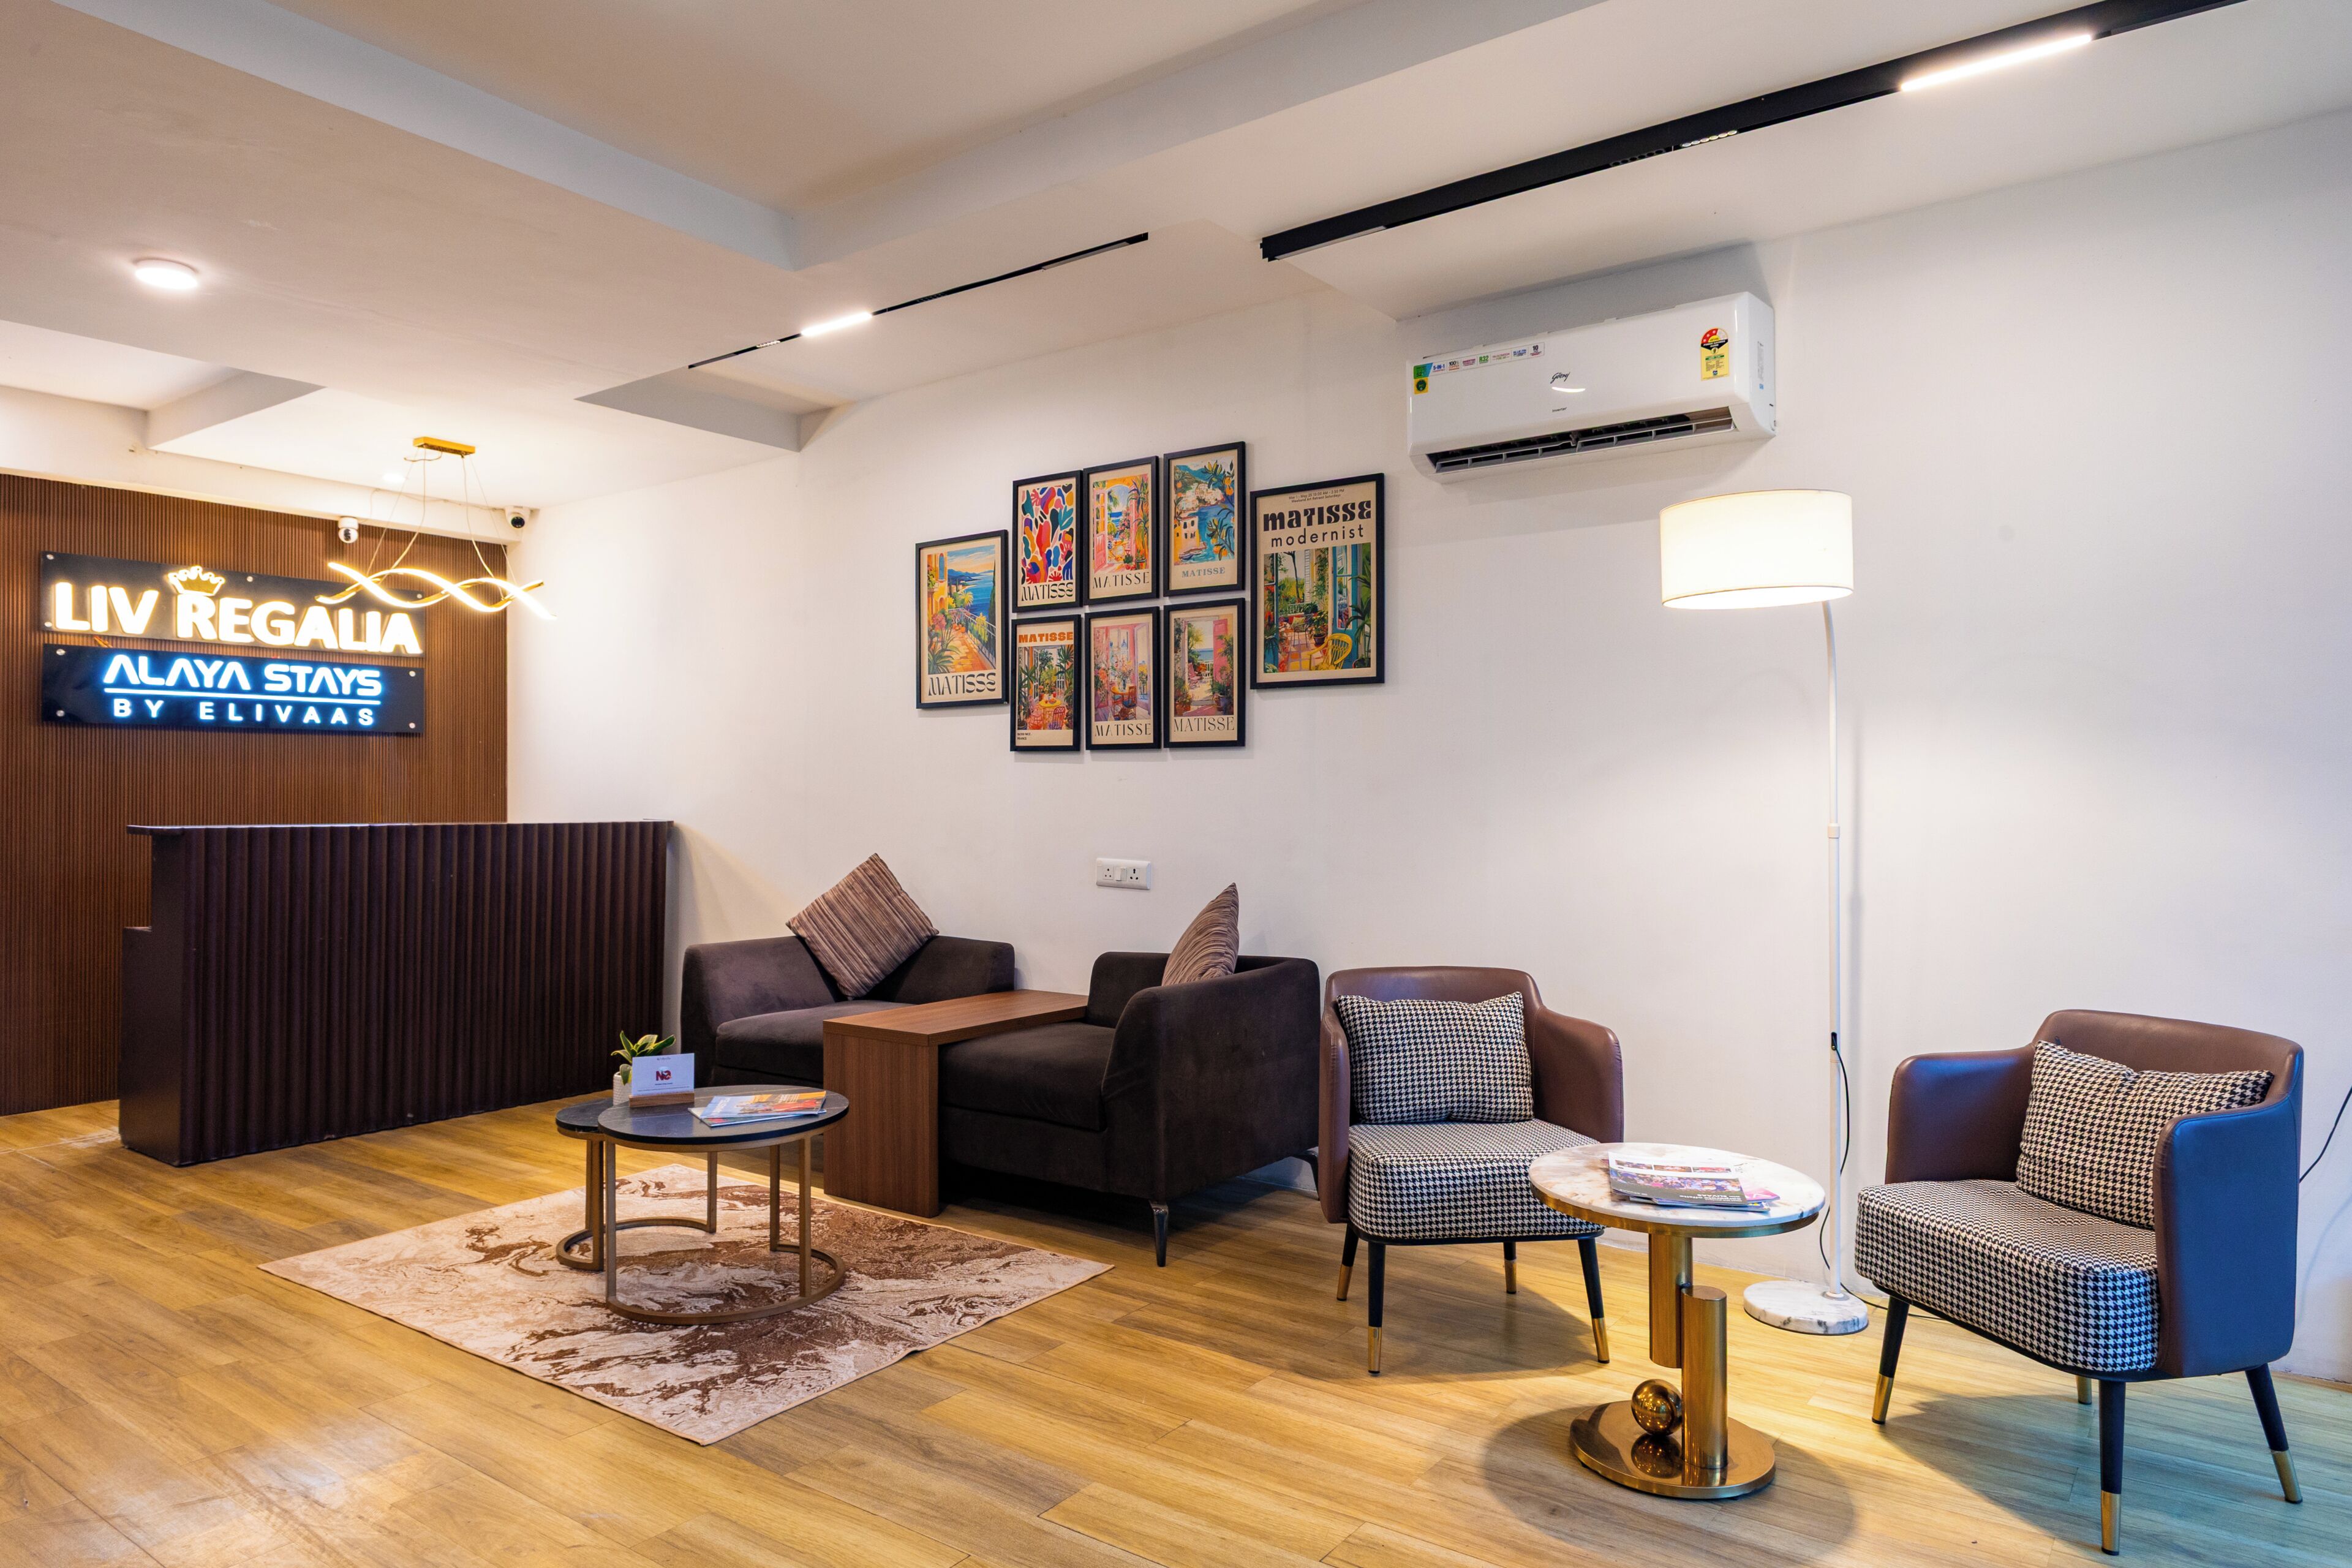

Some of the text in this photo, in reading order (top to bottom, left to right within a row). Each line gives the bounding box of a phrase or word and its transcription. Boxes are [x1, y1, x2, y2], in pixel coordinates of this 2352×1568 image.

[1271, 524, 1363, 548] modernist
[1093, 571, 1150, 589] MATISSE
[1182, 567, 1225, 578] MATISSE
[1021, 582, 1074, 601] MATISSE
[55, 581, 423, 654] LIV REGALIA
[1018, 631, 1074, 643] MATISSE
[104, 654, 382, 696] ALAYA STAYS
[928, 673, 996, 696] MATISSE
[113, 699, 373, 726] BY ELIVAAS
[1095, 722, 1152, 737] MATISSE
[1174, 717, 1235, 733] MATISSE
